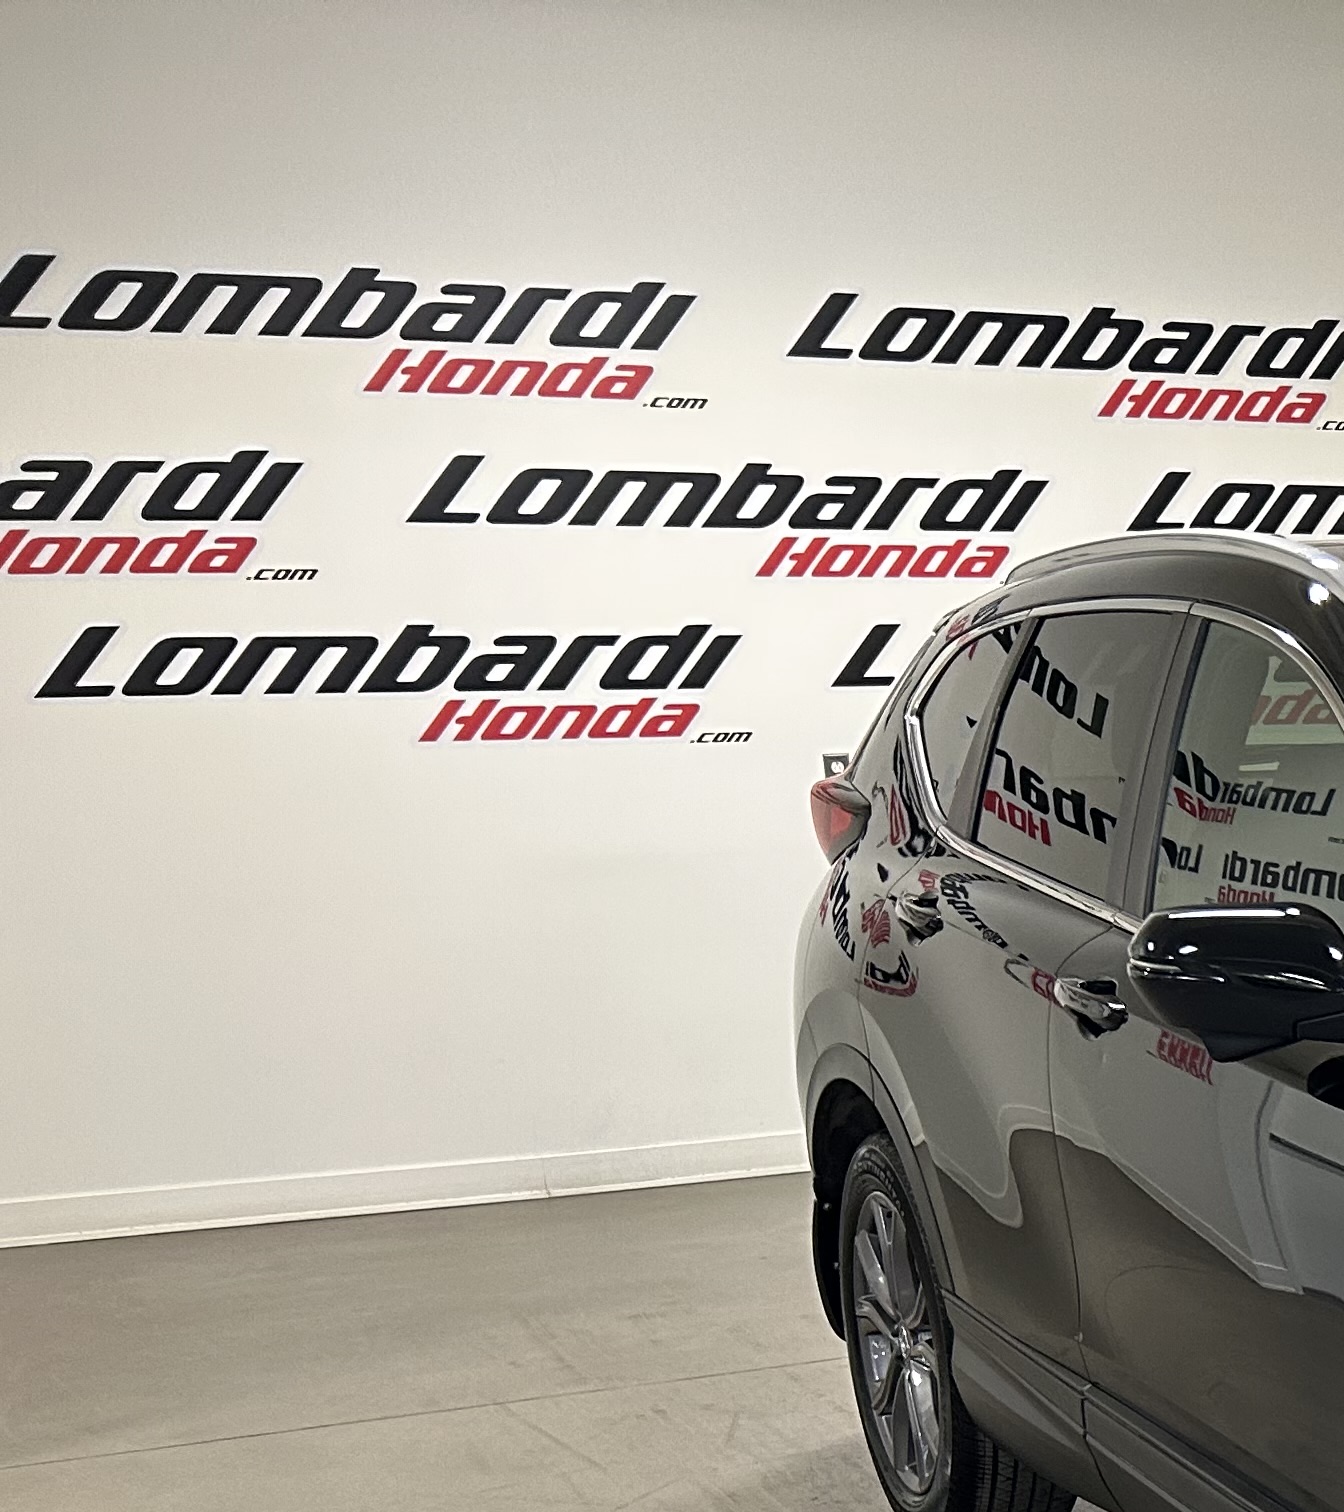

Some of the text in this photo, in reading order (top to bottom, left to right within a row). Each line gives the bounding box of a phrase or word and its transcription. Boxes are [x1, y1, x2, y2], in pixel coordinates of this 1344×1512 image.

[0, 255, 697, 350] Lombardi
[365, 349, 708, 409] Honda .com
[1099, 379, 1326, 423] Honda
[406, 455, 1049, 532] Lombardi
[246, 569, 318, 580] .com
[757, 537, 1009, 578] Honda
[34, 625, 742, 698] Lombardi
[420, 698, 752, 743] Honda .com
